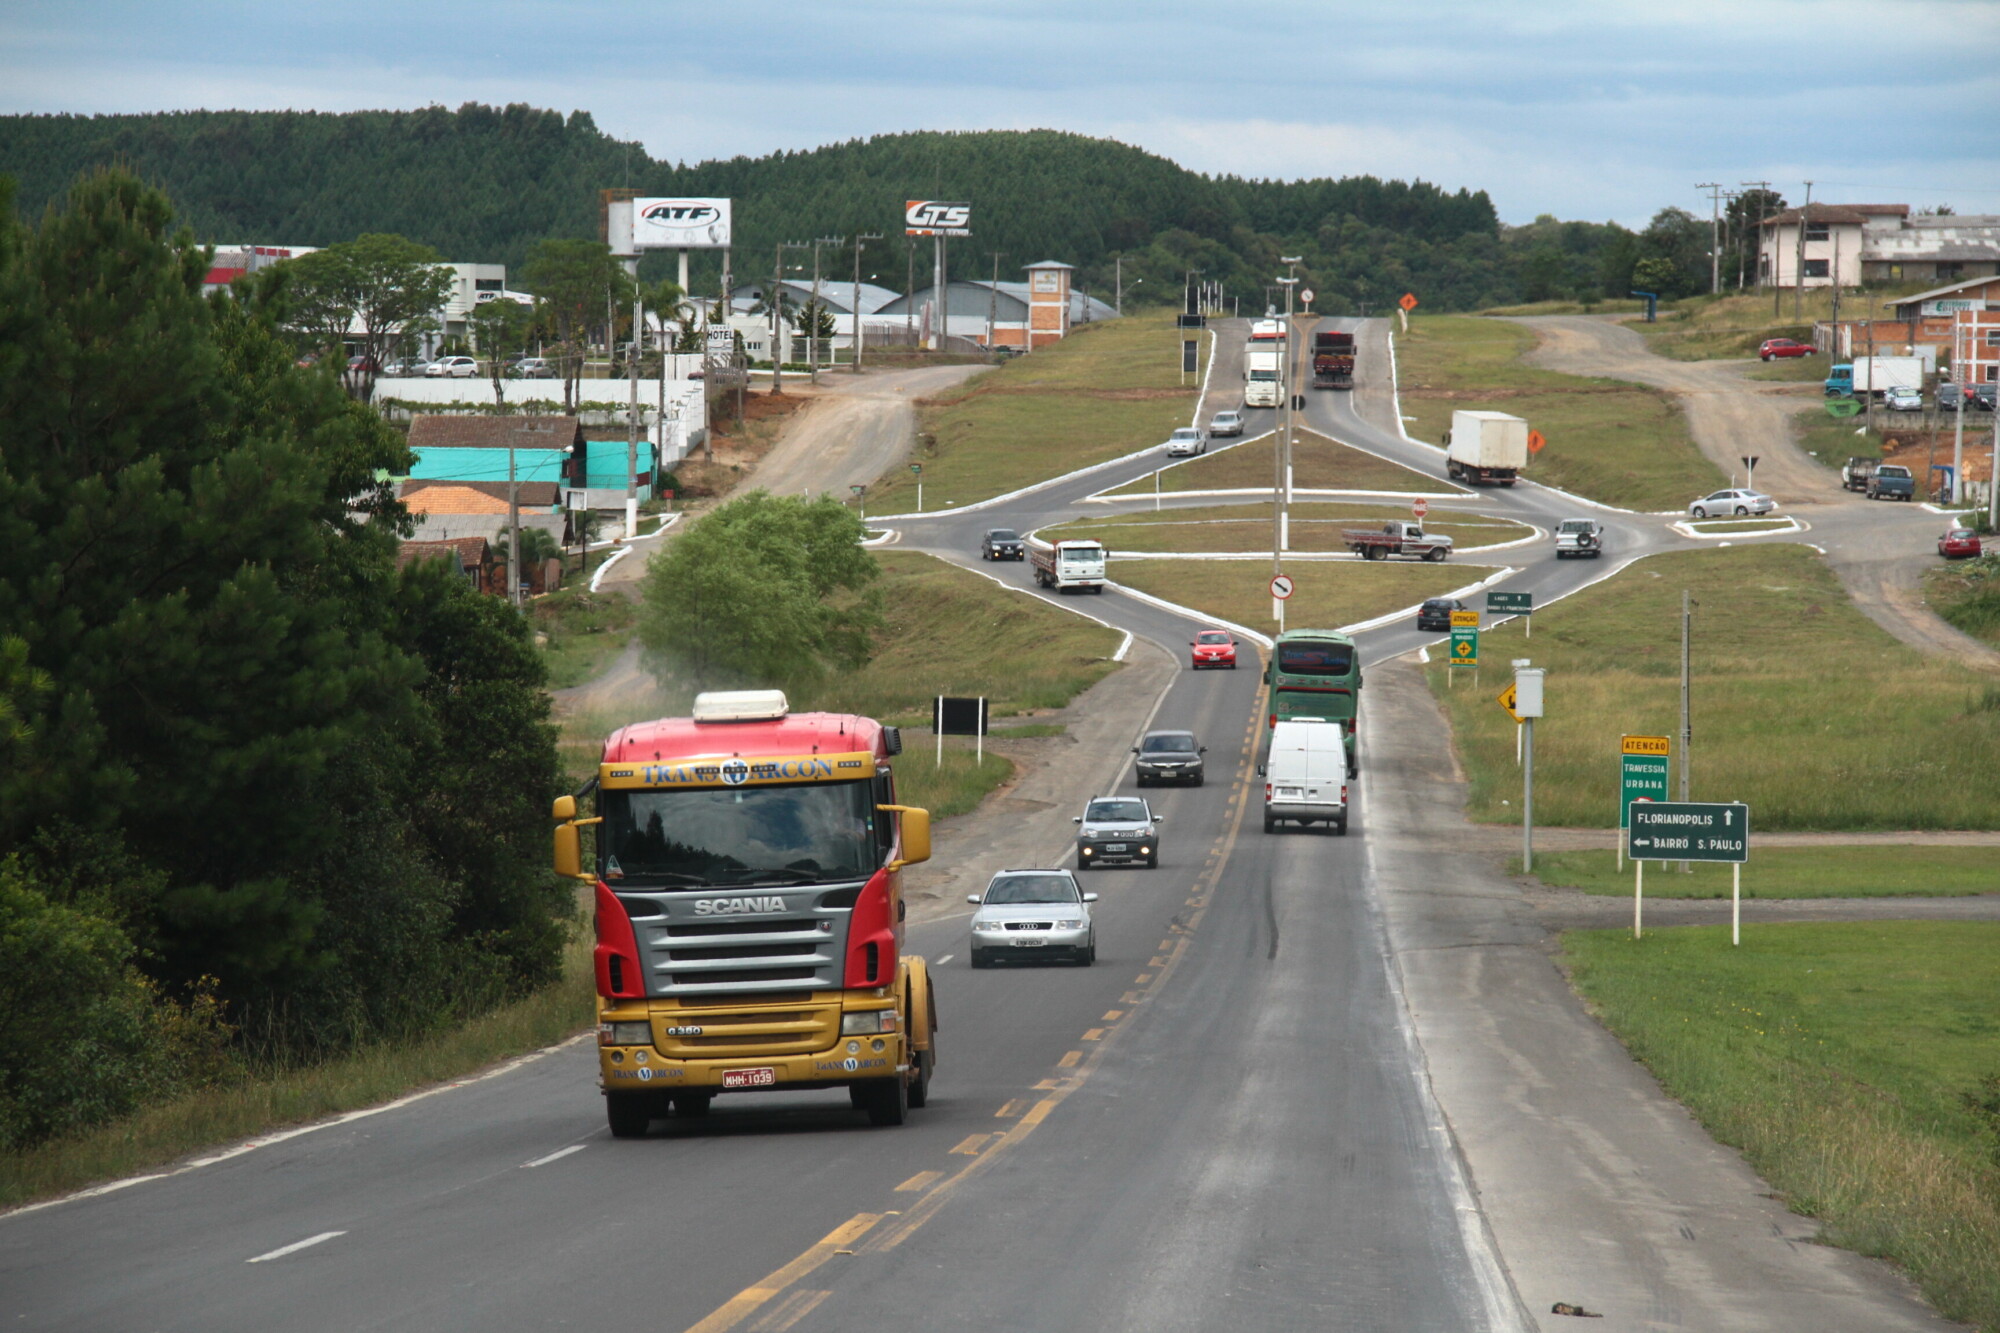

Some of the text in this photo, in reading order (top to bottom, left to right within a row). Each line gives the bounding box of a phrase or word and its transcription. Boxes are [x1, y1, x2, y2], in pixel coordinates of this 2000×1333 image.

[645, 207, 713, 219] ATF
[906, 201, 970, 226] GTS
[707, 330, 734, 340] HOTEL
[1624, 764, 1665, 774] TRAVESSIA
[1625, 779, 1663, 789] URBANA
[1637, 813, 1713, 825] FLORIANOPOLIS
[1653, 837, 1742, 851] BAIRRO S. PAULO
[694, 896, 787, 915] SCANIA
